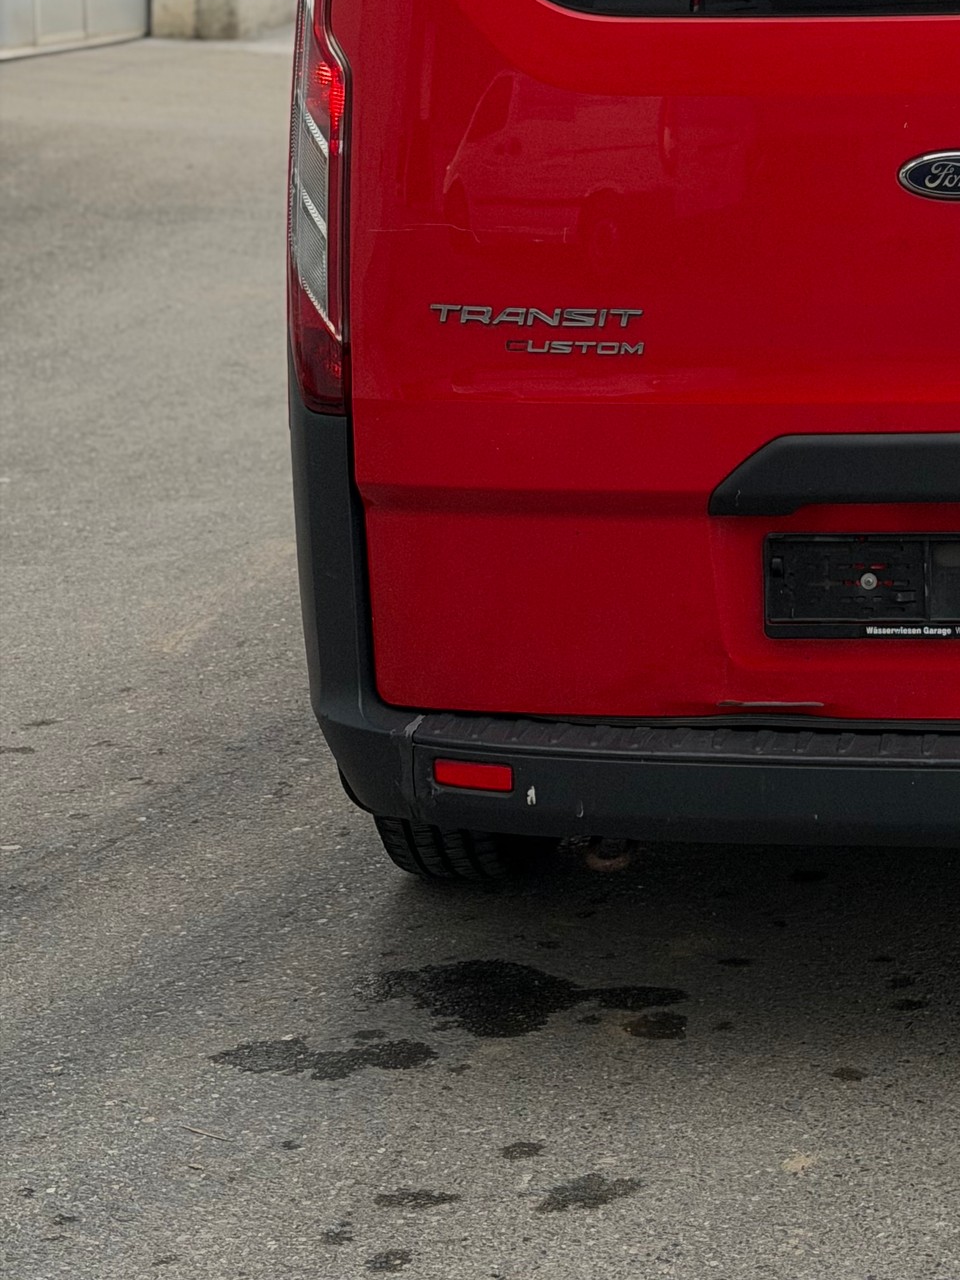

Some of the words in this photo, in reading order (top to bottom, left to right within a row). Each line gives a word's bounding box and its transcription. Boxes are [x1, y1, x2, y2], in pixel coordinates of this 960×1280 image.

[430, 303, 643, 328] TRANSIT
[505, 340, 645, 356] CUSTOM
[923, 626, 952, 636] Garage
